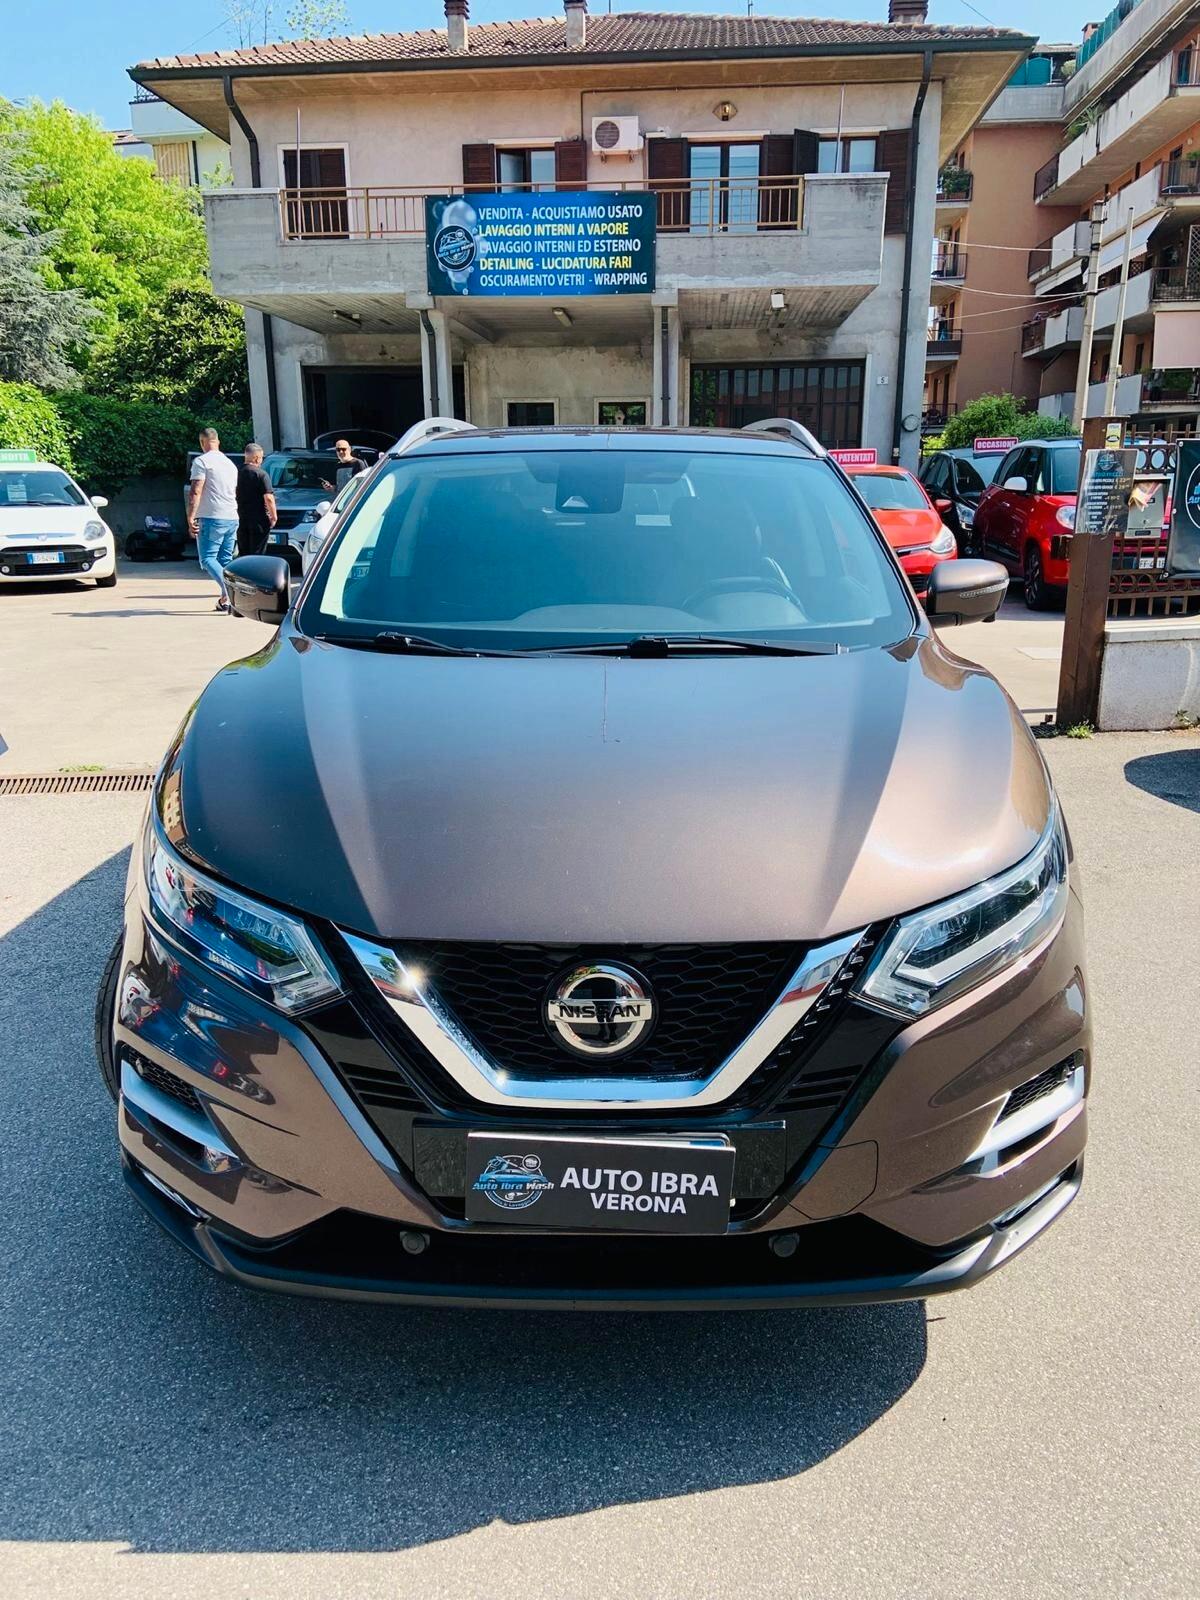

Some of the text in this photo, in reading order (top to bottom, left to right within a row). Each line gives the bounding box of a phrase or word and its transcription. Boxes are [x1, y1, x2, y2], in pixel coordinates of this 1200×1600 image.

[479, 207, 523, 220] VENDITA
[532, 206, 606, 219] ACQUISTIAMO
[608, 205, 643, 218] USATO
[479, 222, 629, 237] LAVAGGIO INTERNI A VAPORE
[480, 240, 532, 254] LAVAGGIO
[534, 240, 575, 253] INTERNI
[577, 239, 592, 252] ED
[594, 238, 641, 252] ESTERNO
[480, 257, 534, 270] DETAILING
[542, 257, 607, 269] LUCIDATURA
[609, 256, 632, 269] FARI
[480, 273, 555, 287] OSCURAMENTO
[557, 273, 585, 286] VETRI
[594, 272, 648, 286] WRAPPING
[977, 440, 1016, 449] OCCASIONE
[838, 453, 874, 463] PATENTATI
[472, 1181, 555, 1190] Auto Ibra Wash
[559, 1167, 719, 1197] AUTO IBRA
[590, 1192, 687, 1214] VERONA
